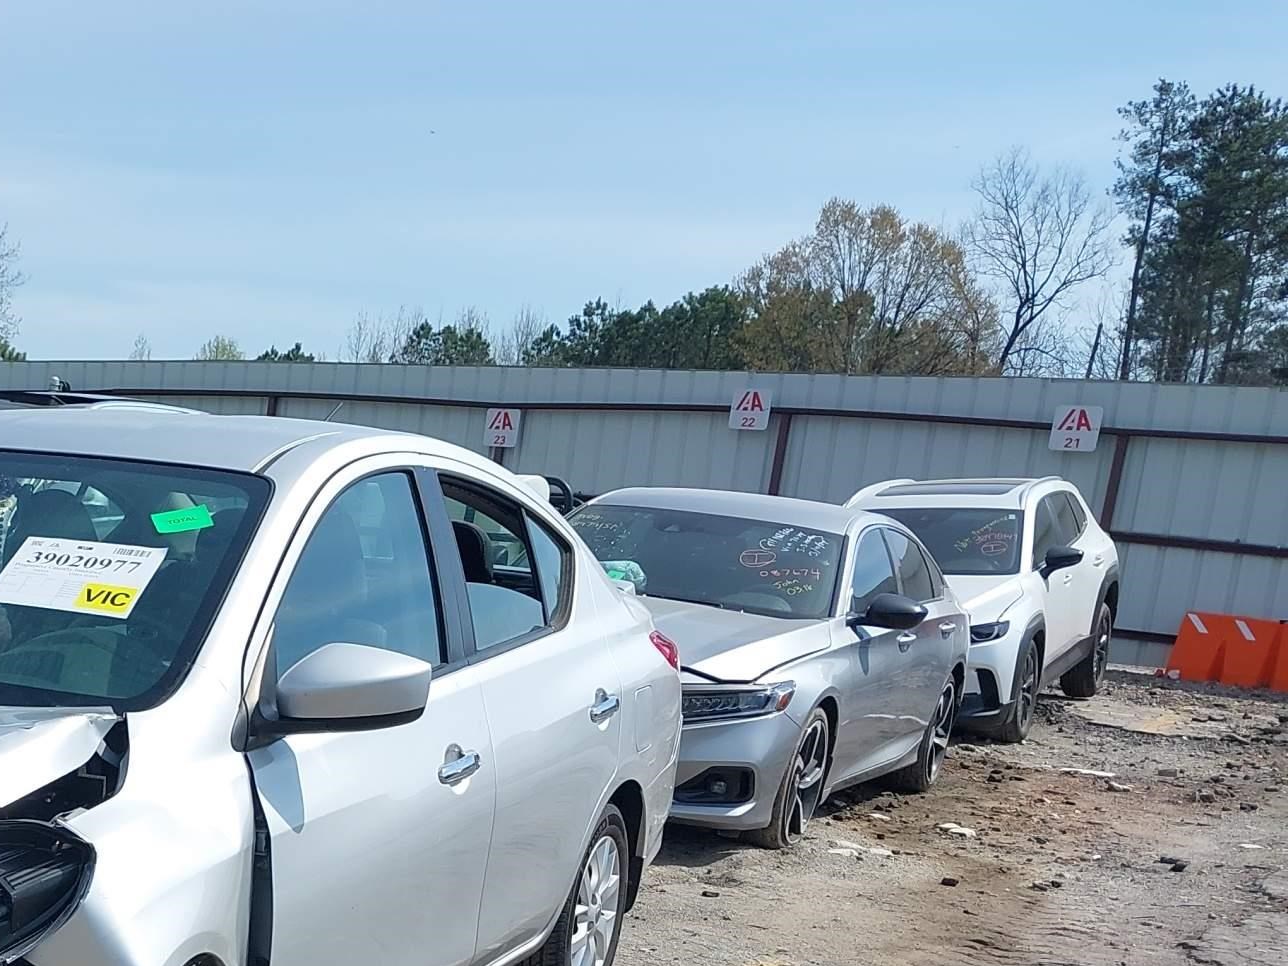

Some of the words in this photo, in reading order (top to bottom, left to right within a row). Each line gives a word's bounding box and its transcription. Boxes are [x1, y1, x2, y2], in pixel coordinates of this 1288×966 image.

[741, 416, 756, 428] 22
[493, 434, 506, 445] 23
[1063, 437, 1081, 449] 21
[167, 516, 198, 525] TOTAL
[26, 551, 143, 574] 39020977
[86, 588, 131, 607] VIC
